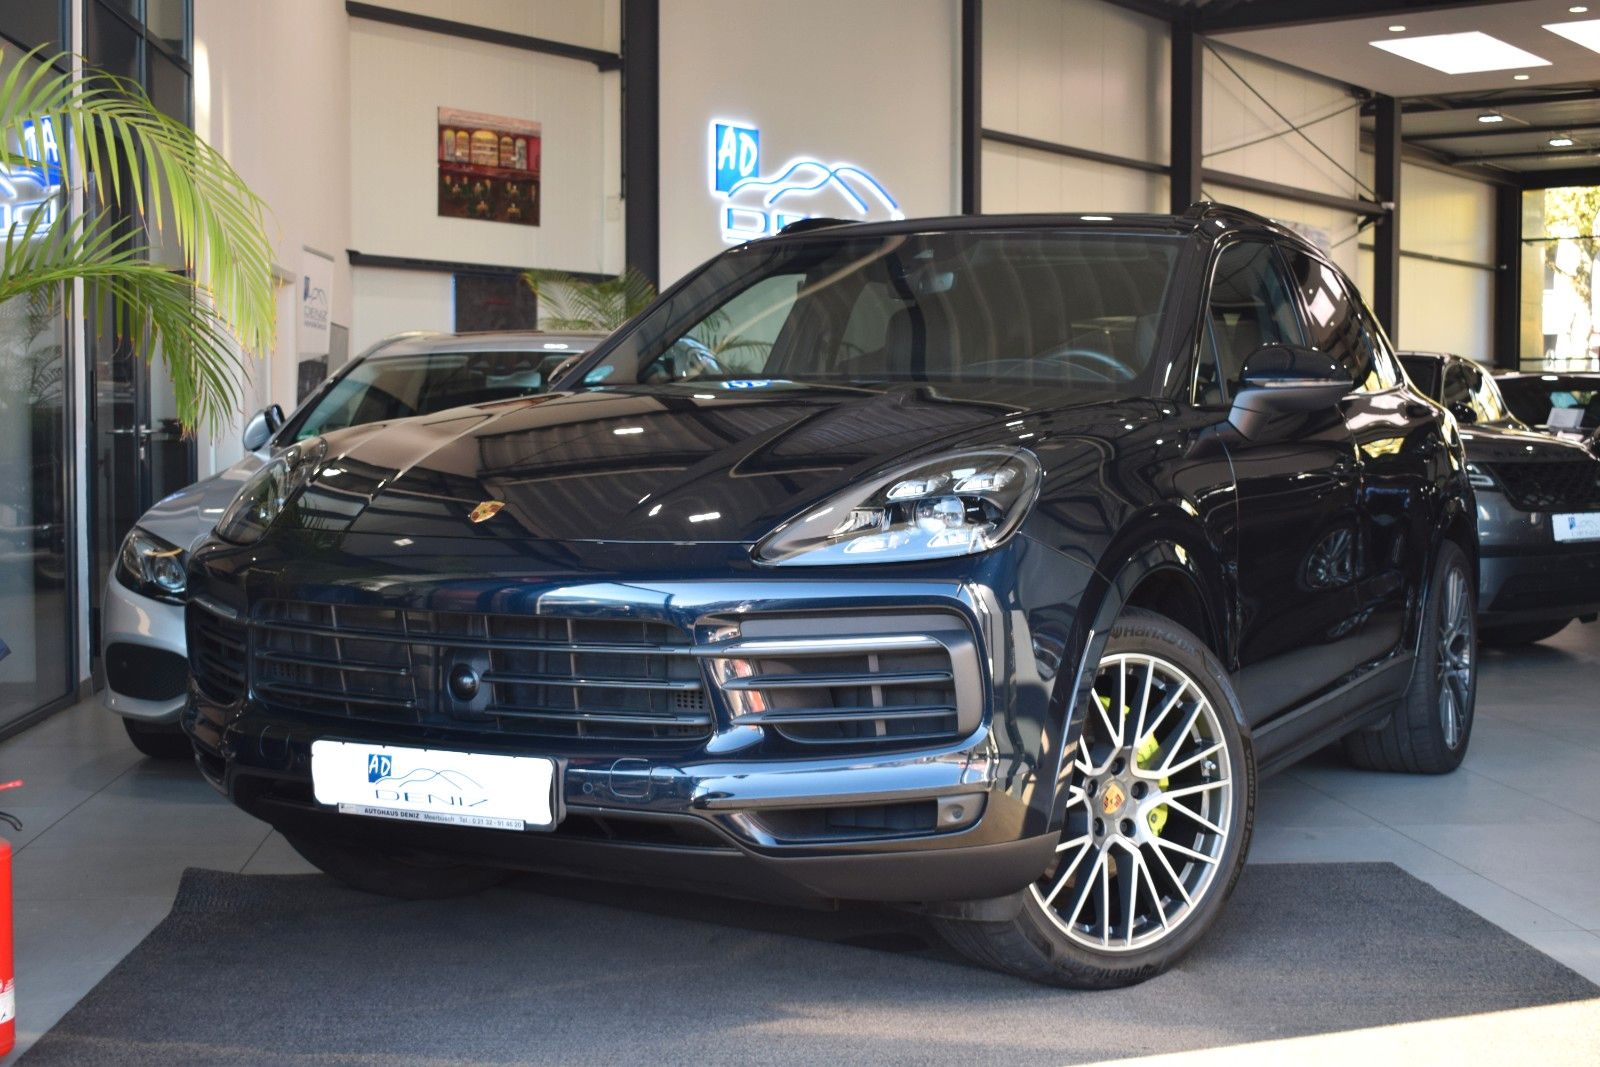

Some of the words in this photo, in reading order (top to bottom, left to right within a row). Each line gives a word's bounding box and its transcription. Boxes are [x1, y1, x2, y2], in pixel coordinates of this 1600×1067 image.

[718, 126, 758, 177] AD
[369, 754, 391, 777] AD
[364, 807, 399, 817] AUTOHAUS
[400, 811, 420, 819] DENIZ
